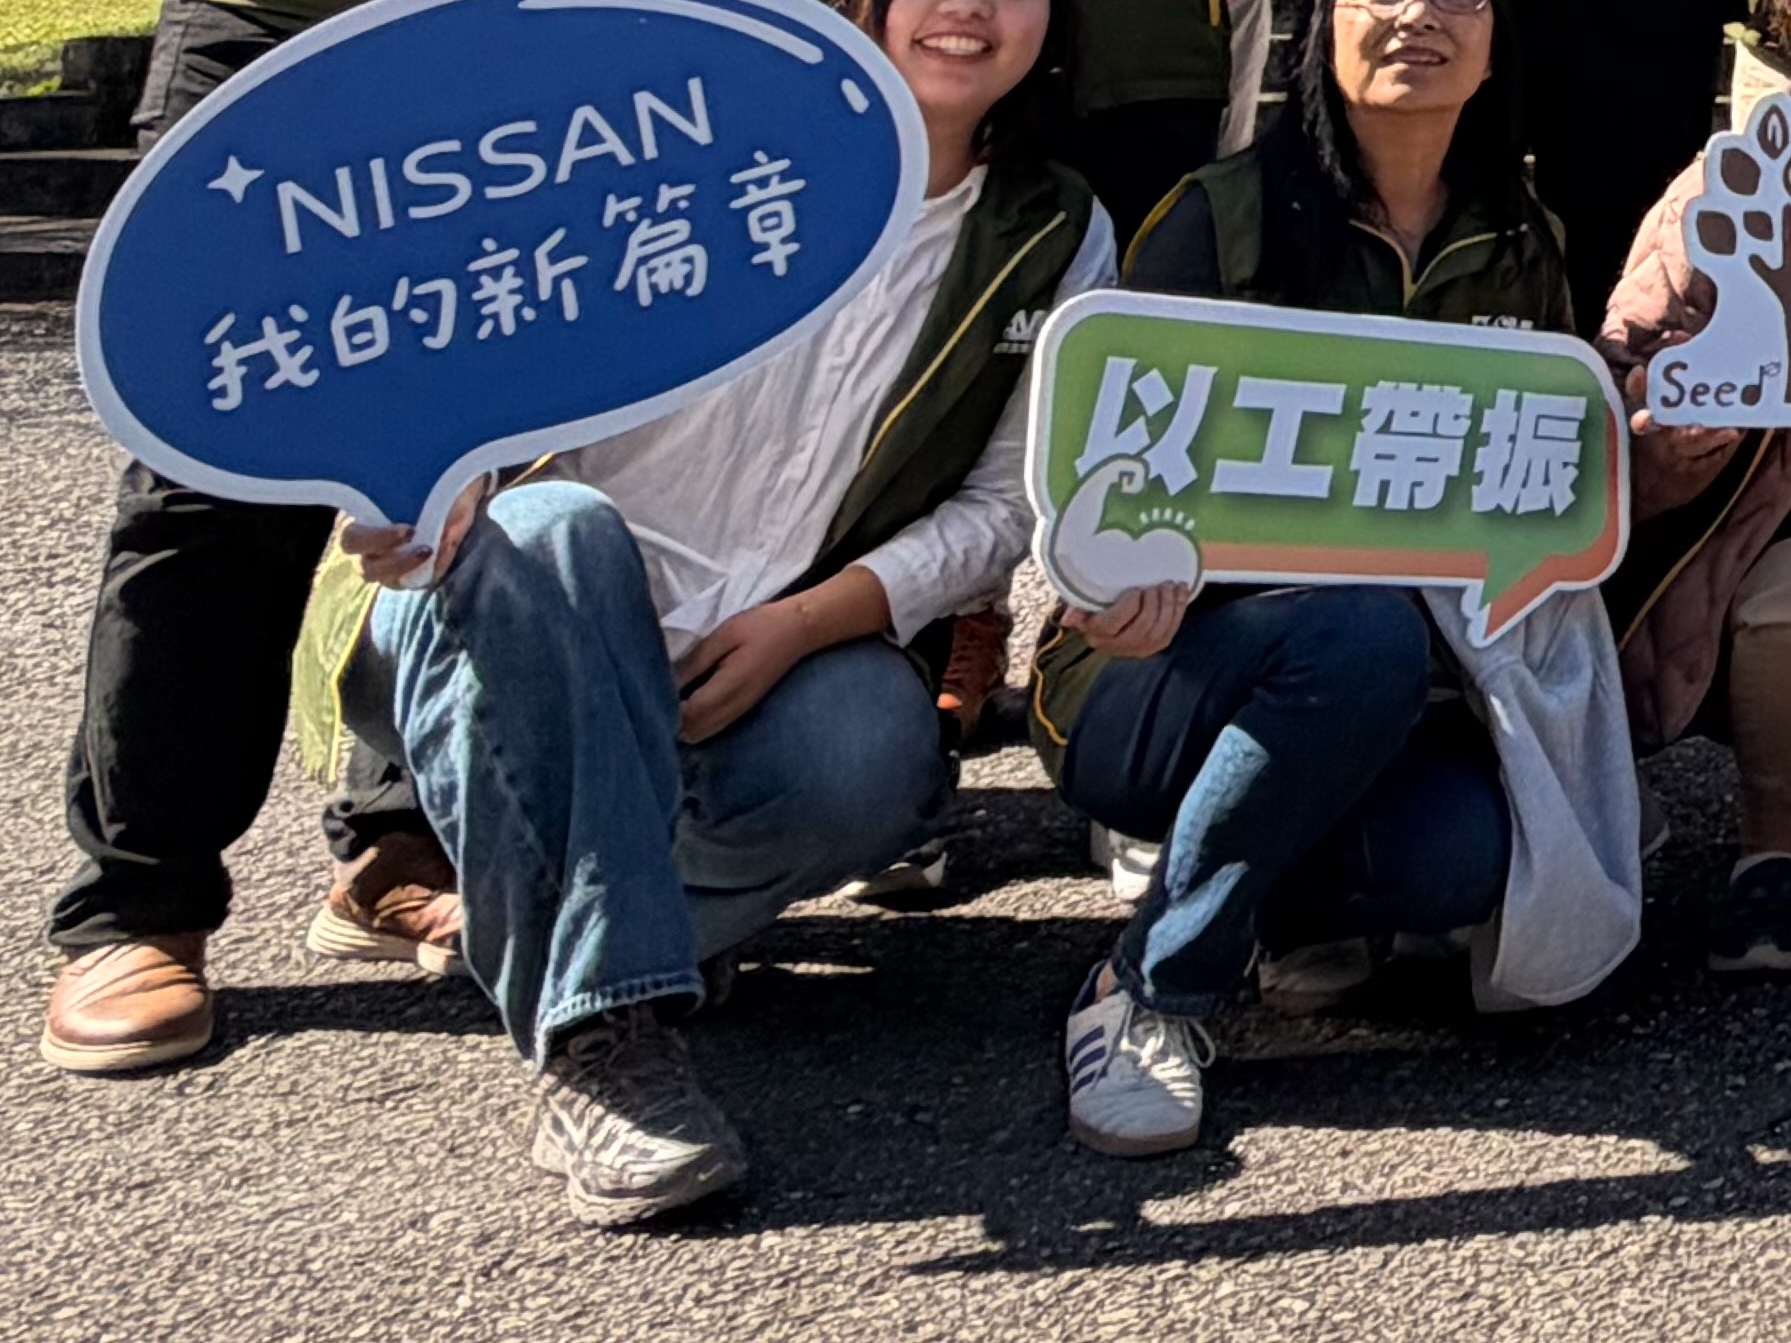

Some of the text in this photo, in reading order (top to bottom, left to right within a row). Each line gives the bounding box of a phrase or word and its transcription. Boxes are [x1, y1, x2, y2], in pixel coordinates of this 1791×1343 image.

[276, 76, 714, 254] NISSAN
[203, 151, 805, 411] 我的新篇章
[1076, 356, 1587, 515] 以工帶振
